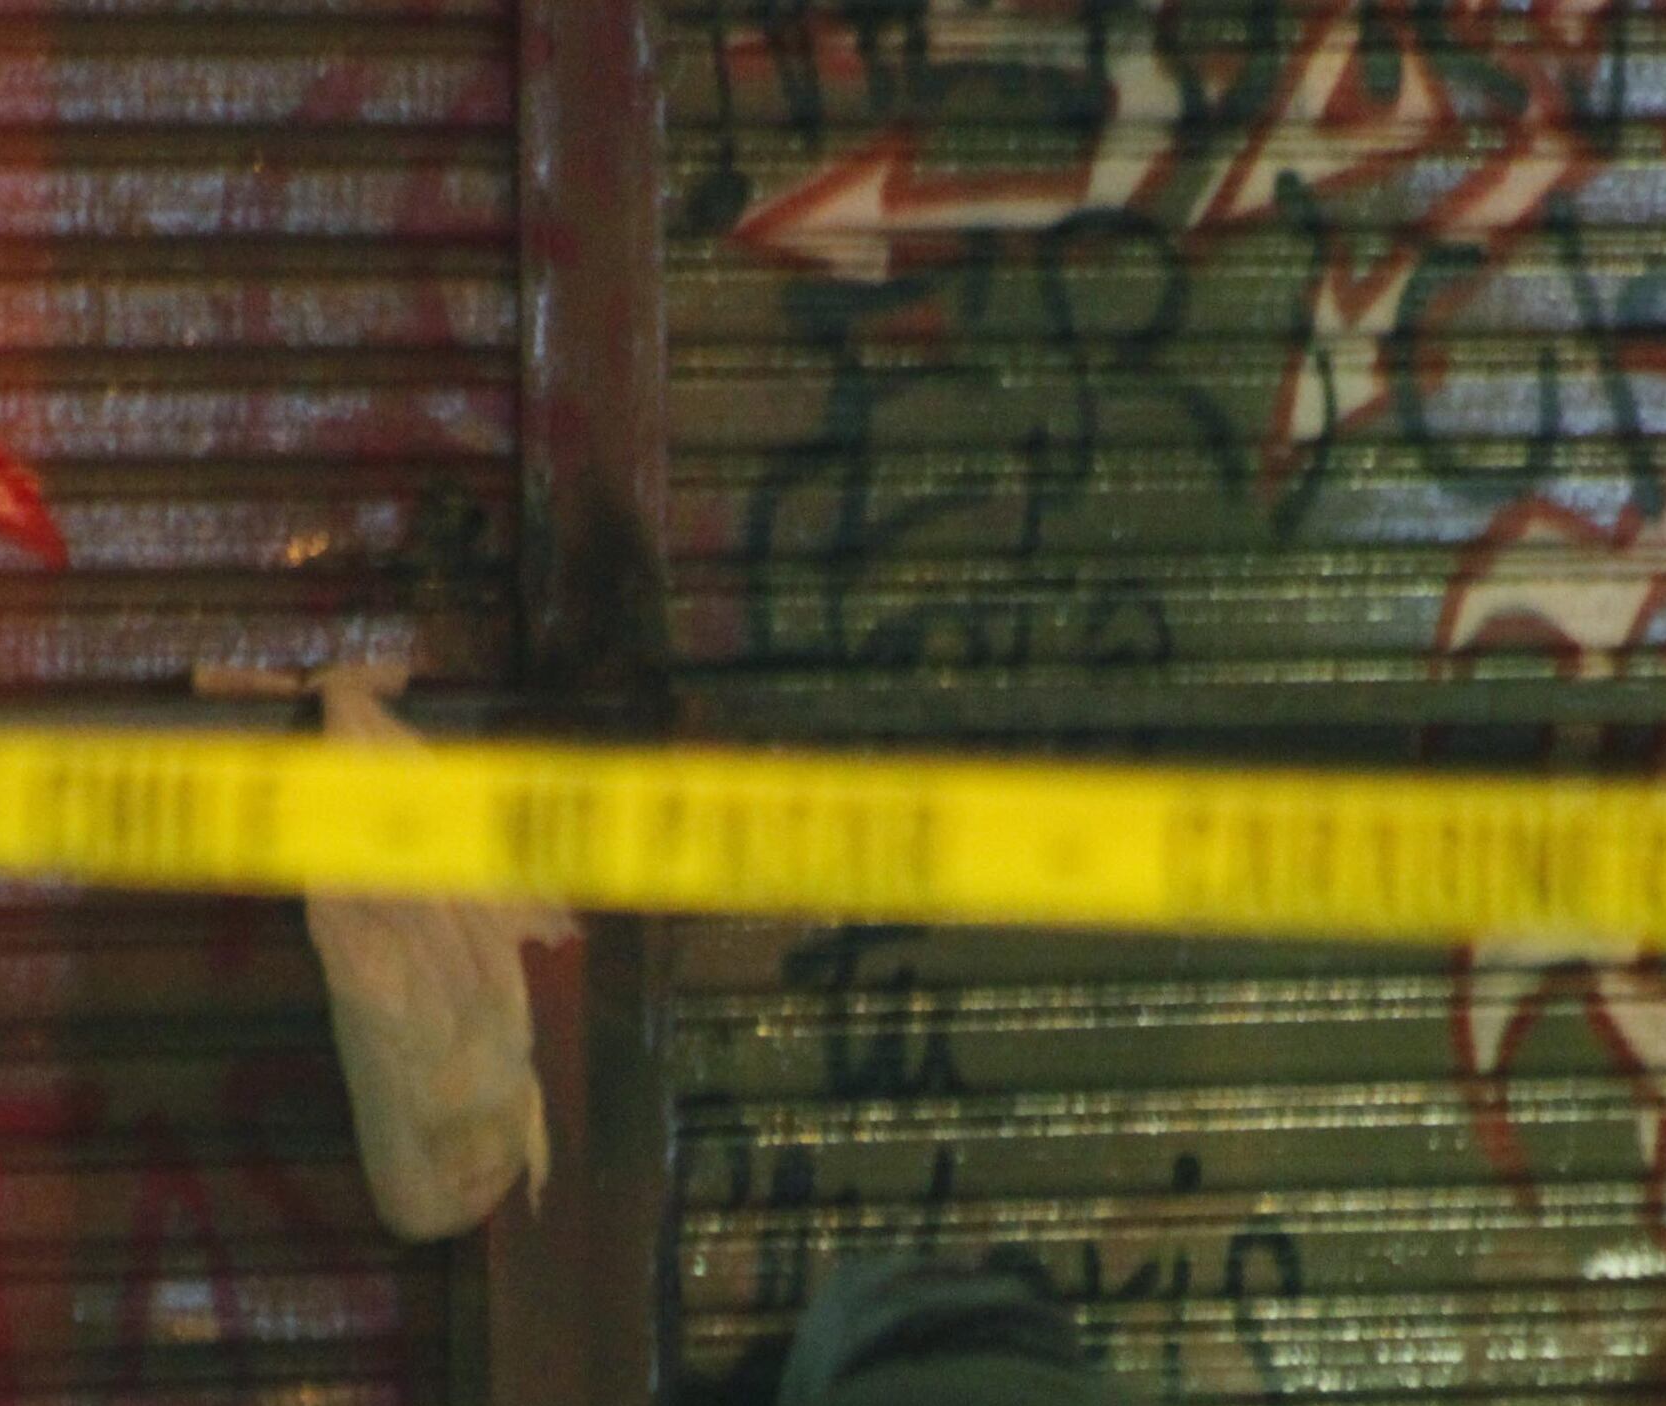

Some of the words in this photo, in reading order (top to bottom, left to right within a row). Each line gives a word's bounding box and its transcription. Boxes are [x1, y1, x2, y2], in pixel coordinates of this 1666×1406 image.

[41, 754, 278, 871] CHILE
[495, 772, 599, 881] NO
[651, 778, 945, 899] PASAR
